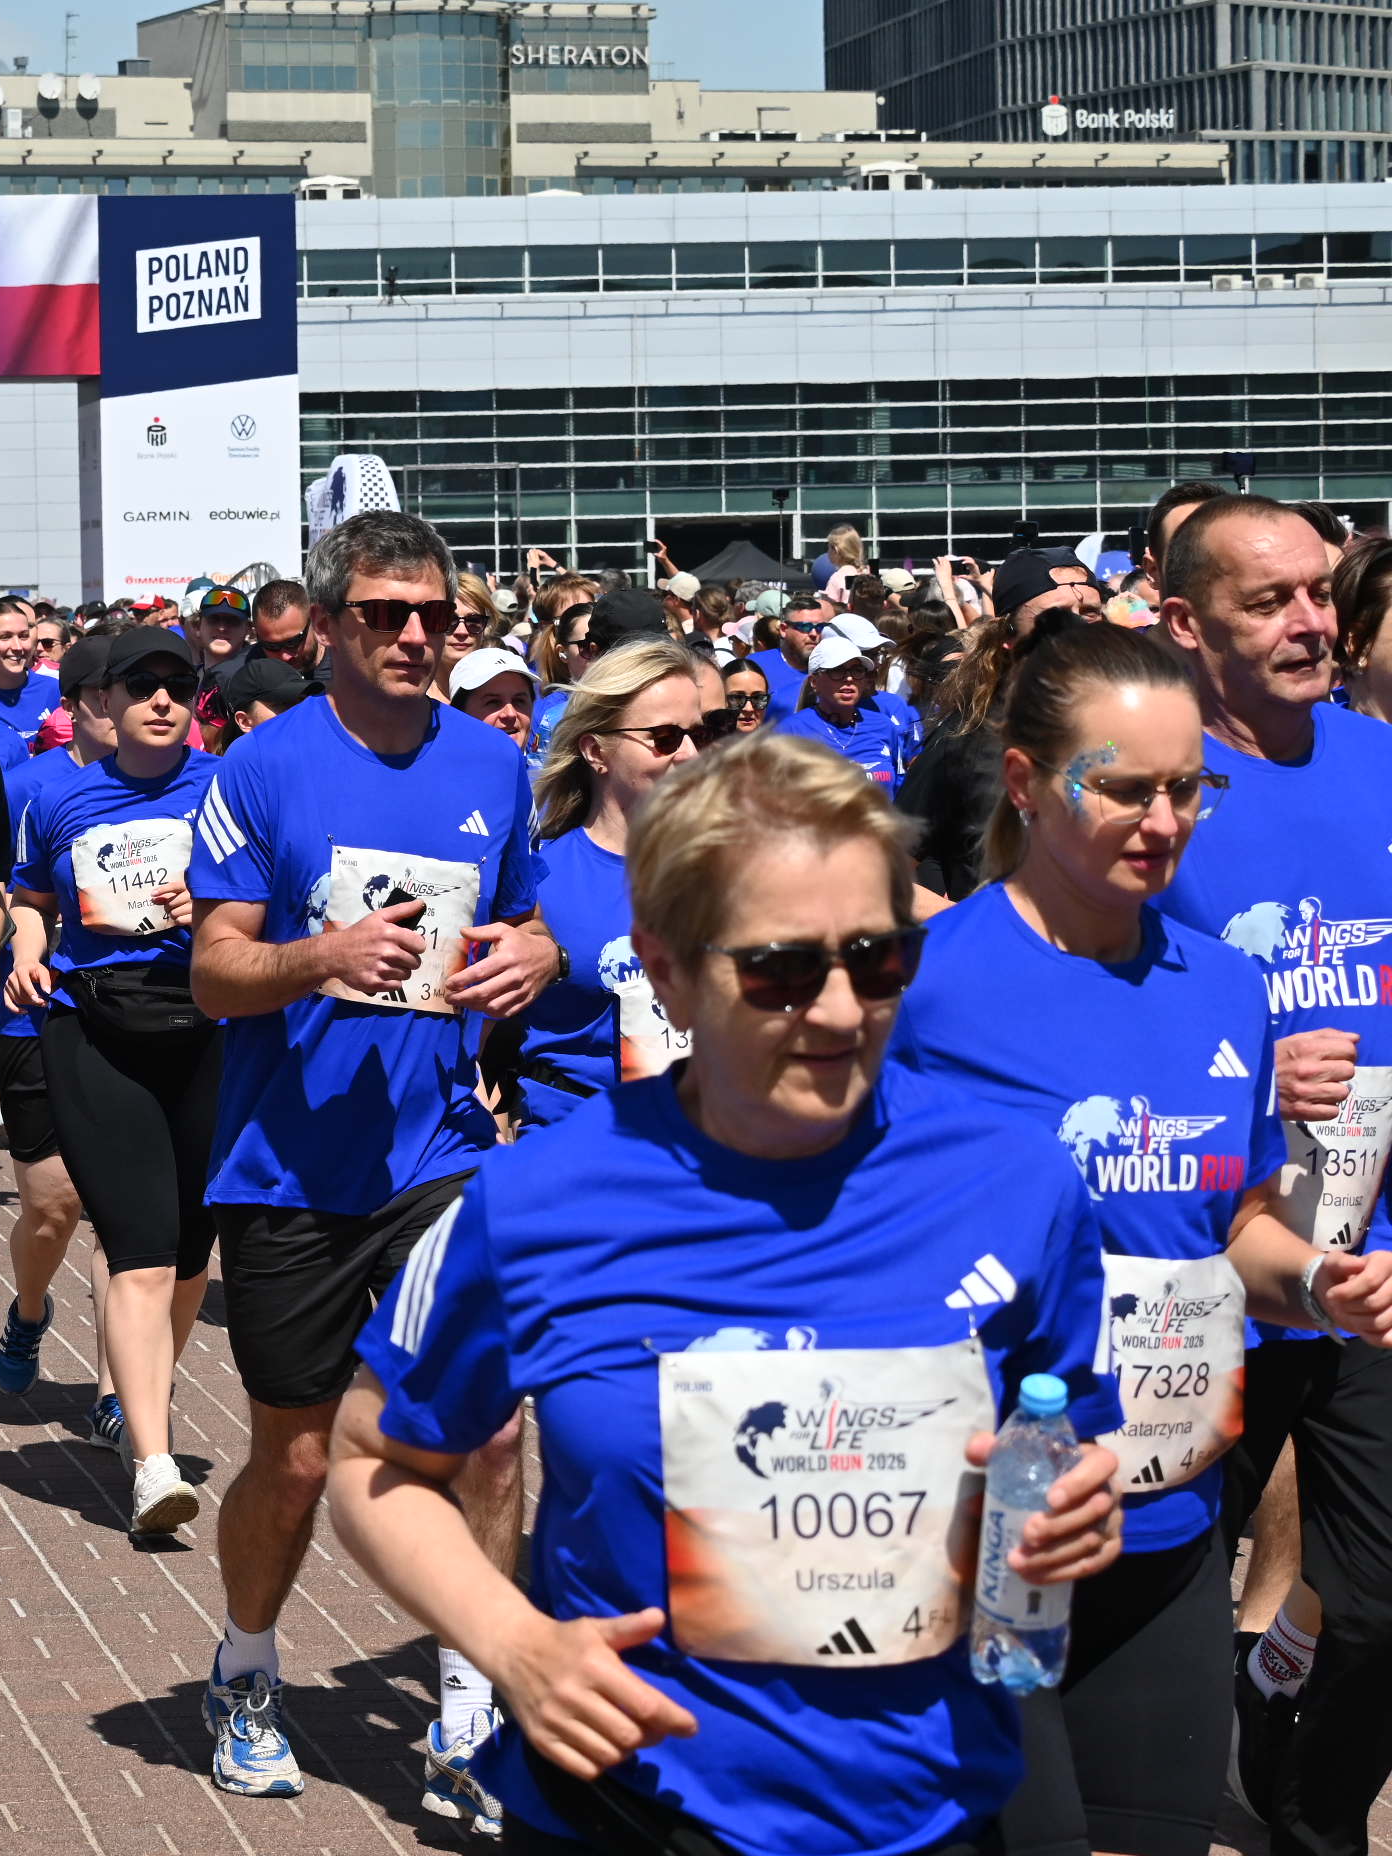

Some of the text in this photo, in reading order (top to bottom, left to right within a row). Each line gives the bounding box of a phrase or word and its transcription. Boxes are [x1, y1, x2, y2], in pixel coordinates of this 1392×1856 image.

[511, 44, 649, 66] SHERATON
[1075, 108, 1120, 129] Bank
[1124, 108, 1174, 129] Polski
[148, 246, 250, 286] POLAND
[148, 276, 250, 324] POZNAŃ
[123, 510, 190, 522] GARMIN
[209, 508, 281, 523] eobuwie.pl
[108, 867, 169, 894] 11442
[393, 879, 435, 895] WINGS
[414, 925, 439, 950] 31
[1285, 923, 1366, 949] WINGS
[1282, 946, 1347, 966] FOR LIFE
[420, 983, 431, 1001] 3
[1263, 965, 1378, 1015] WORLD
[661, 1027, 689, 1049] 13
[1119, 1118, 1188, 1138] WINGS
[1337, 1112, 1365, 1125] LIFE
[1316, 1125, 1377, 1137] WORLD RUN 2026
[1118, 1136, 1172, 1155] FOR LIFE
[1095, 1153, 1244, 1193] WORLD RUN
[1305, 1147, 1378, 1177] 13511
[1143, 1300, 1205, 1317] WINGS
[1150, 1317, 1188, 1334] LIFE
[1121, 1334, 1205, 1350] WORLD RUN 2026
[795, 1406, 896, 1429] WINGS
[809, 1428, 867, 1451] LIFE
[770, 1452, 907, 1473] WORLD RUN 2026
[1180, 1447, 1194, 1471] 4
[759, 1489, 928, 1541] 10067
[981, 1509, 1006, 1603] KINGA
[795, 1567, 897, 1593] Urszula
[901, 1605, 925, 1639] 4
